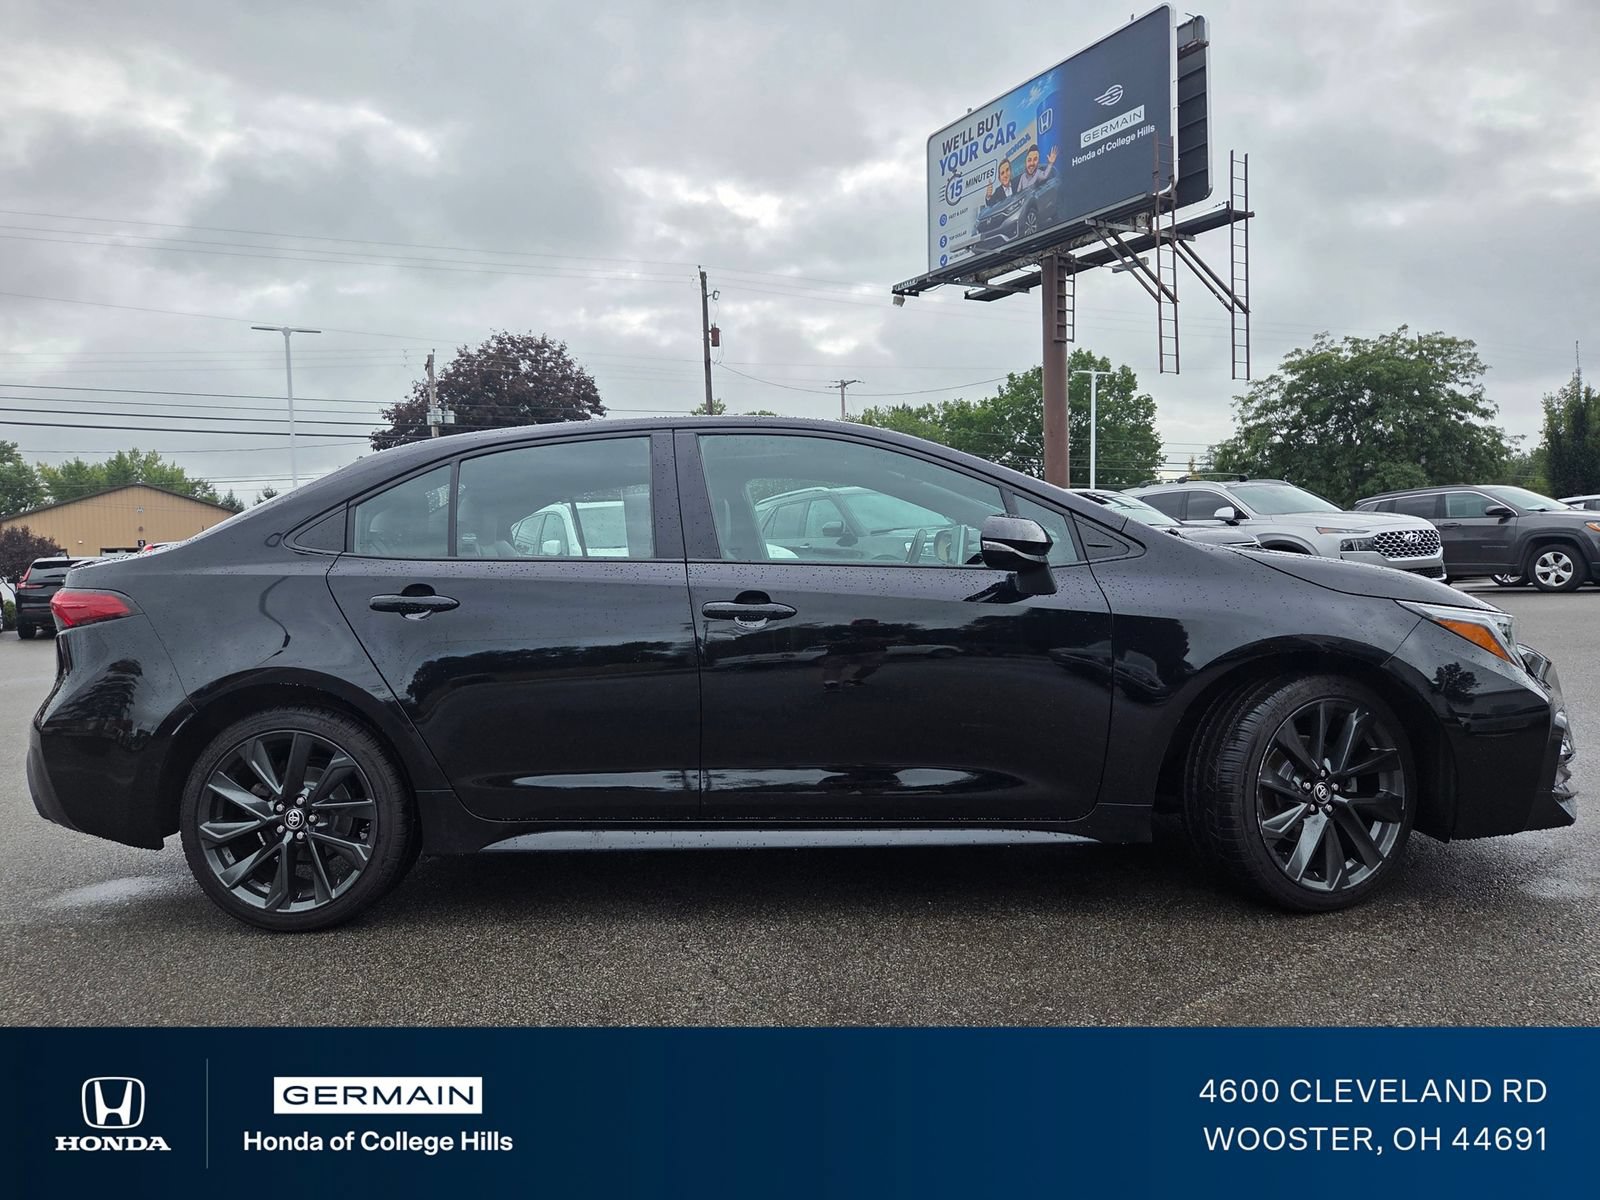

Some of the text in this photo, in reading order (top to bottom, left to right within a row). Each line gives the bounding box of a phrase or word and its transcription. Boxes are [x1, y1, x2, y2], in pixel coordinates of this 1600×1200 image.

[942, 109, 1003, 155] WE'LL BUY
[1072, 124, 1156, 166] Honda of College Hills
[1083, 110, 1142, 143] GERMAIN
[939, 121, 1017, 176] YOUR CAR
[950, 168, 995, 200] 15 MINUTES
